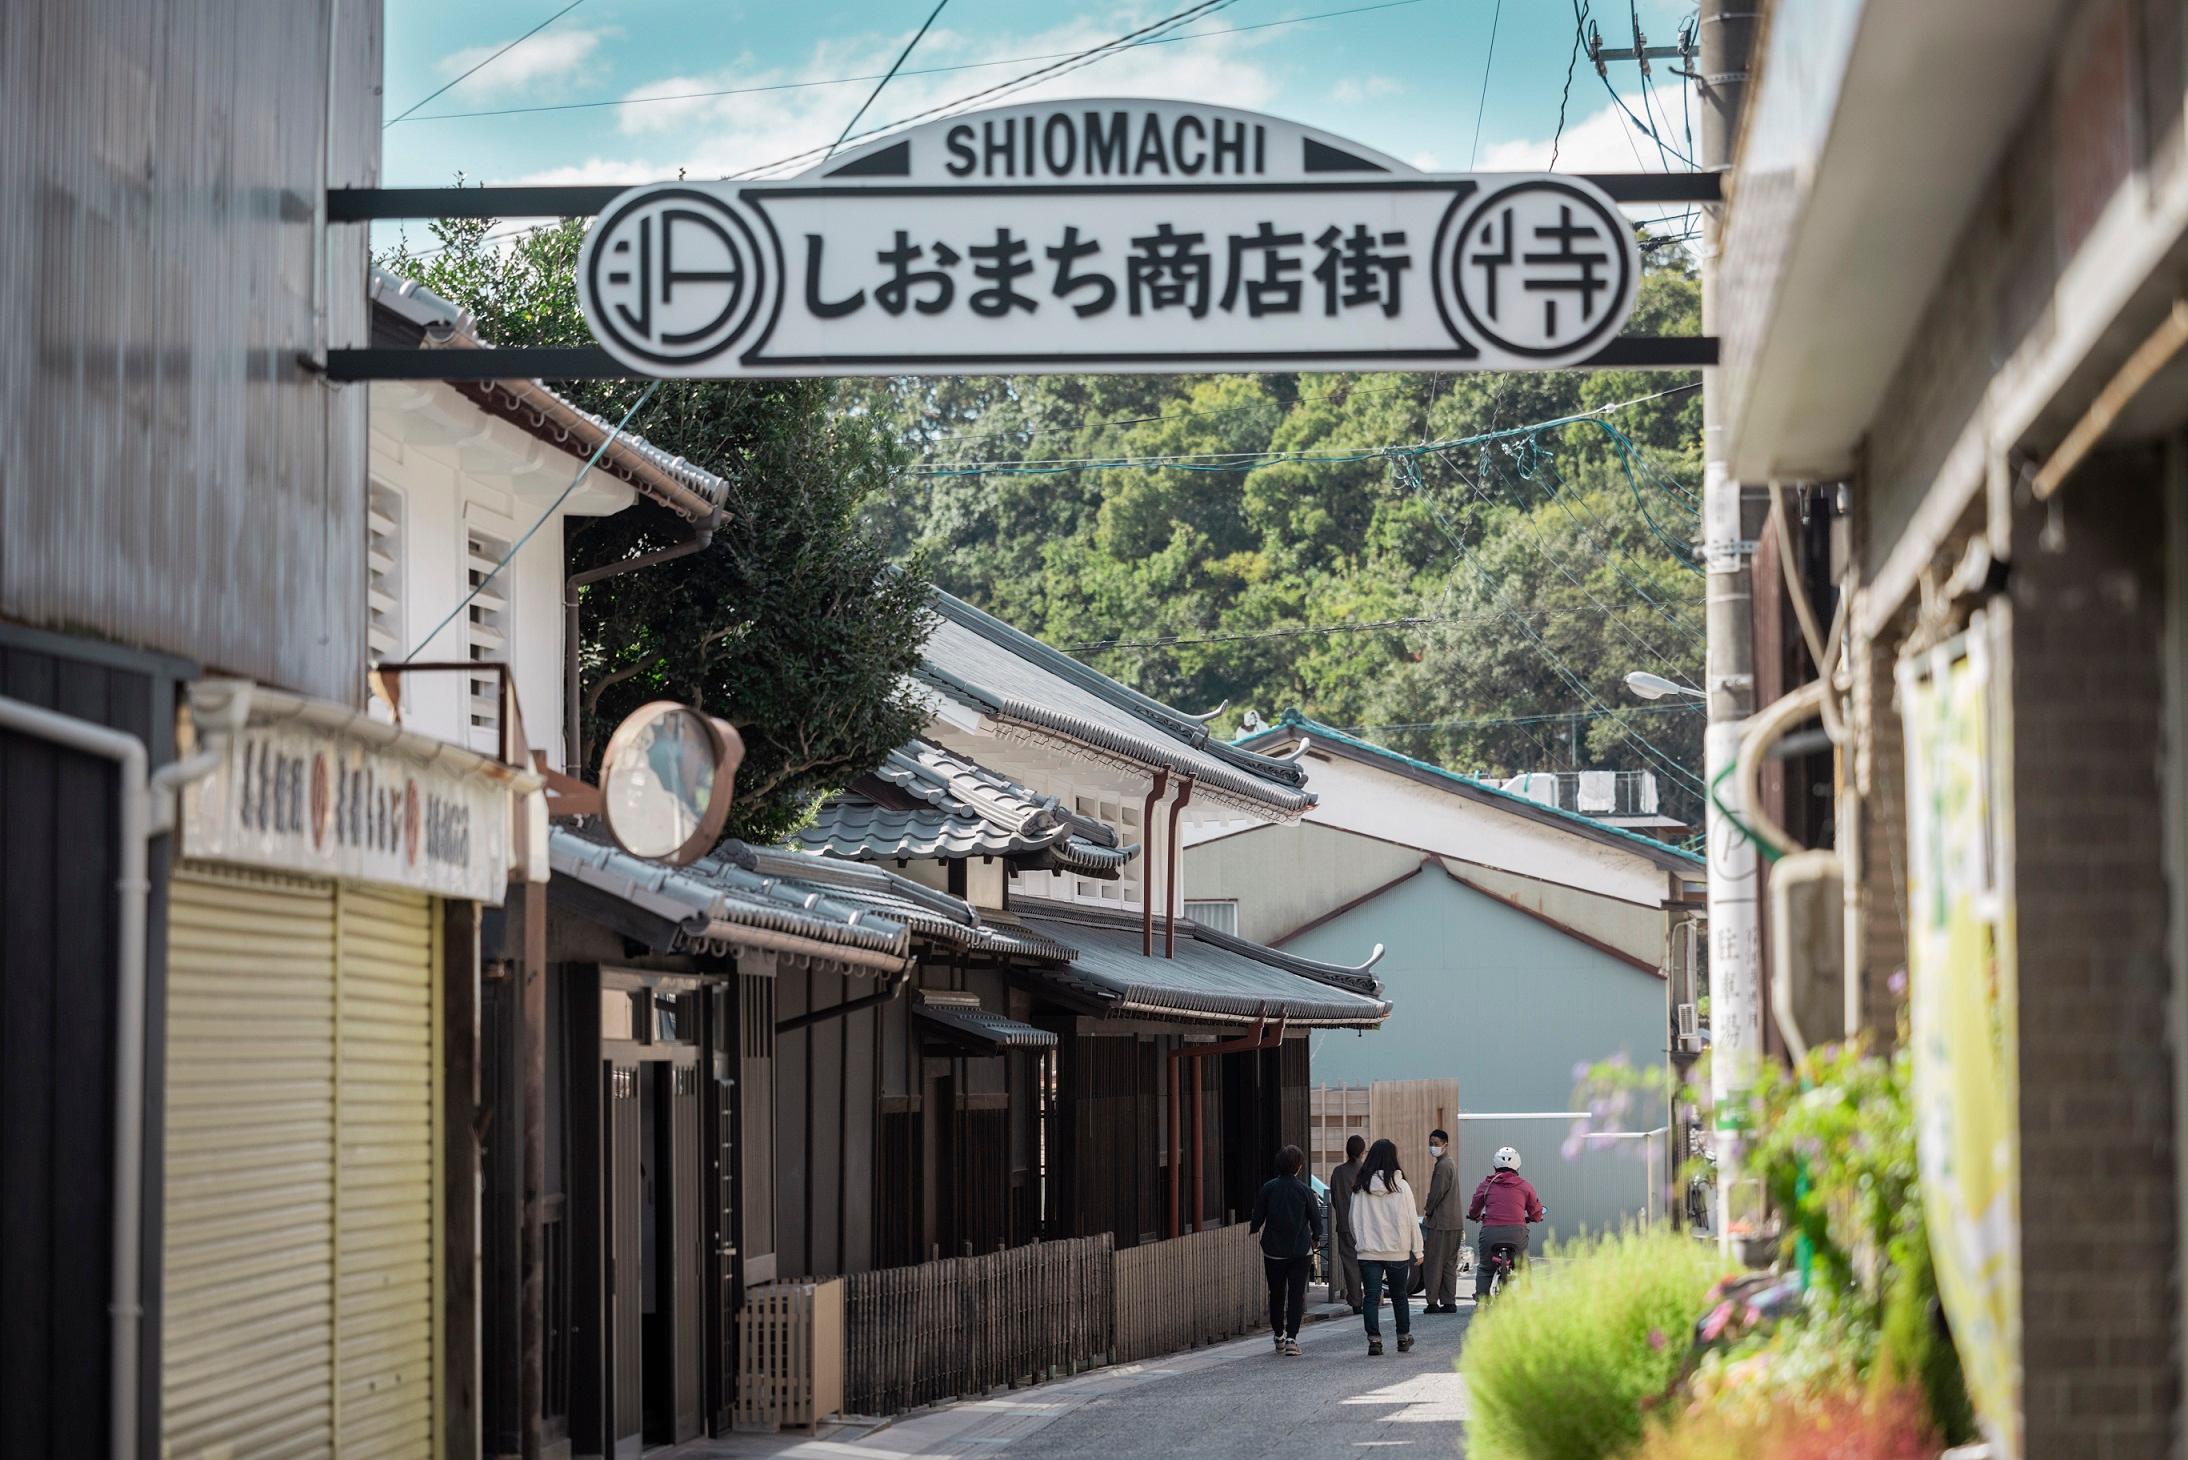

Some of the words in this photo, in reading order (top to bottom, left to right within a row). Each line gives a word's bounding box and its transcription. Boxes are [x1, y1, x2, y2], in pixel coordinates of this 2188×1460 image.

[945, 111, 1266, 178] SHIOMACHI
[804, 222, 1411, 319] しおまち商店街
